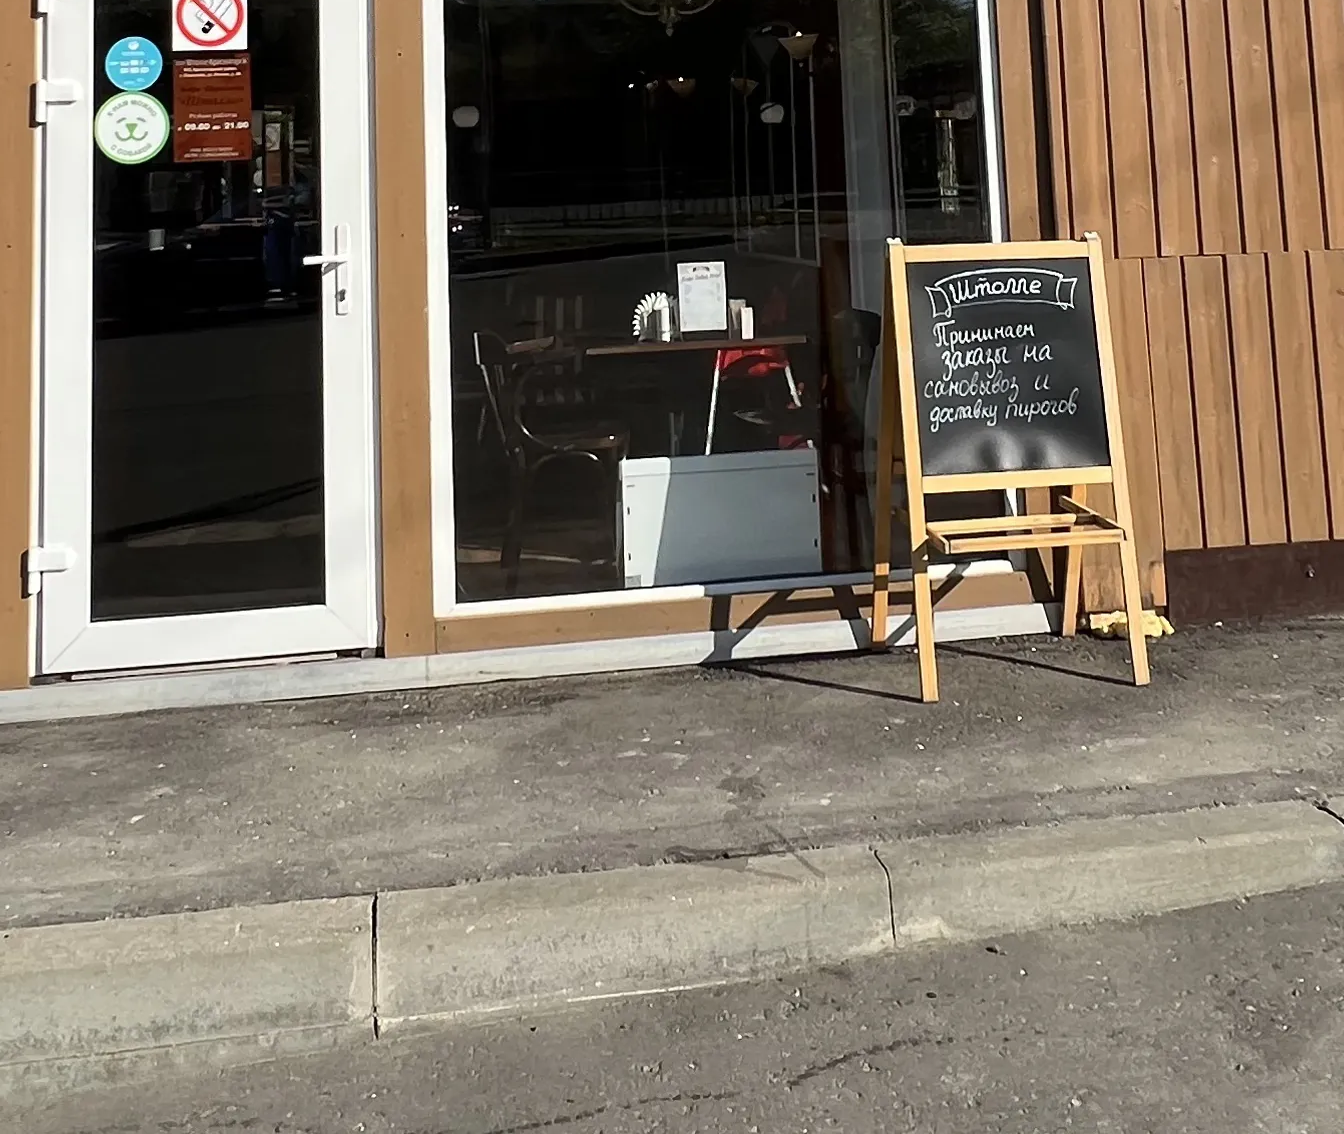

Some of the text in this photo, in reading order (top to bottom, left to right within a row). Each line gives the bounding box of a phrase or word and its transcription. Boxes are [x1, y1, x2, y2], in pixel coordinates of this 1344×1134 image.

[948, 277, 1042, 304] Штолле
[941, 343, 1054, 382] заказы на
[1034, 373, 1051, 391] и
[929, 386, 1080, 433] доставку пирогов
